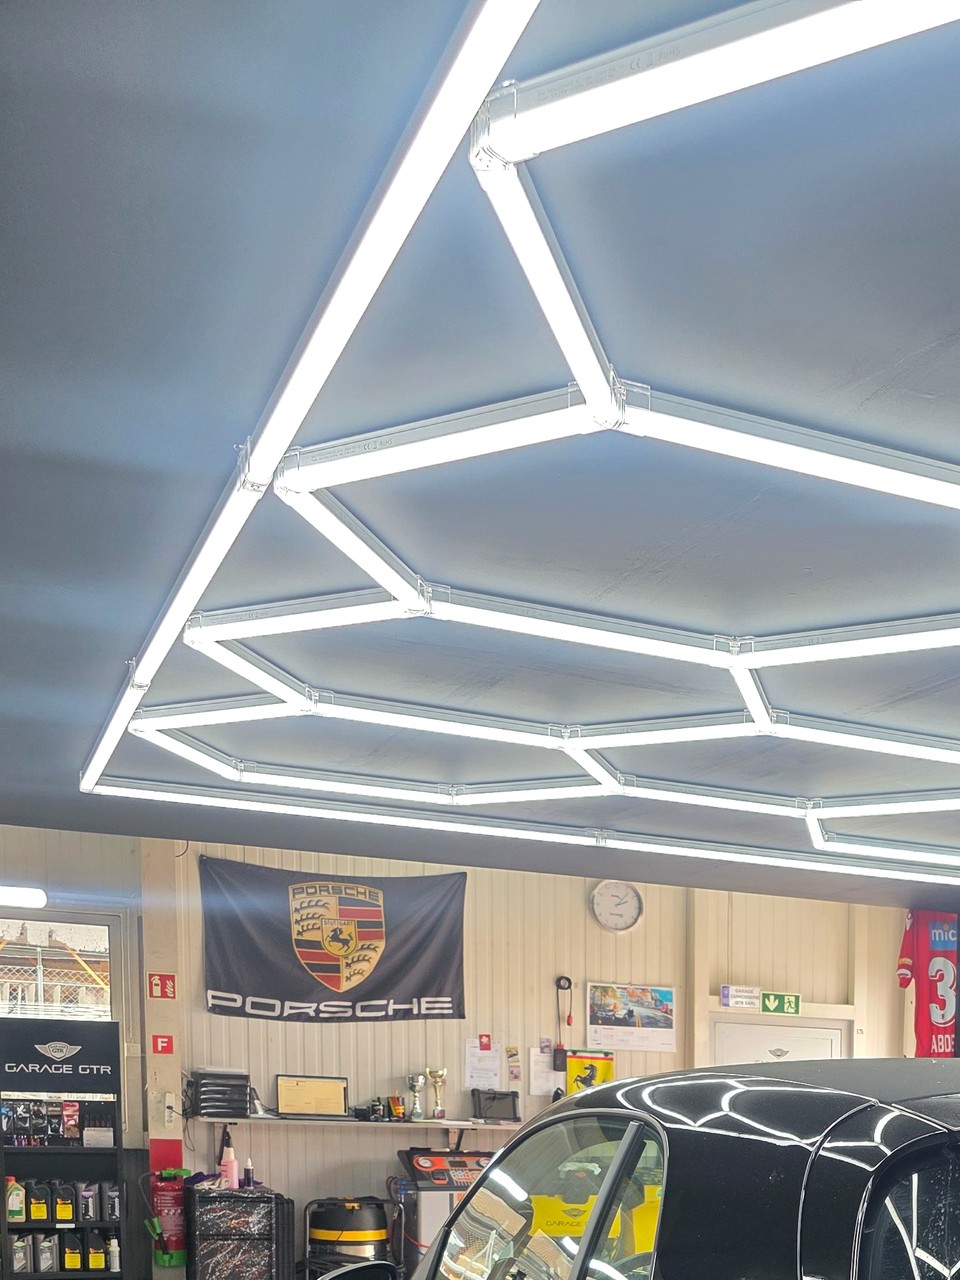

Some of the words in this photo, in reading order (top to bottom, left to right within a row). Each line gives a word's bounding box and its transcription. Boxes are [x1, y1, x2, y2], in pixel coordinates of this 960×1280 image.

[292, 886, 380, 902] PORSCHE
[206, 989, 454, 1018] PORSCHE
[157, 1038, 168, 1051] F
[5, 1063, 73, 1074] GARAGE
[78, 1065, 111, 1075] GTR
